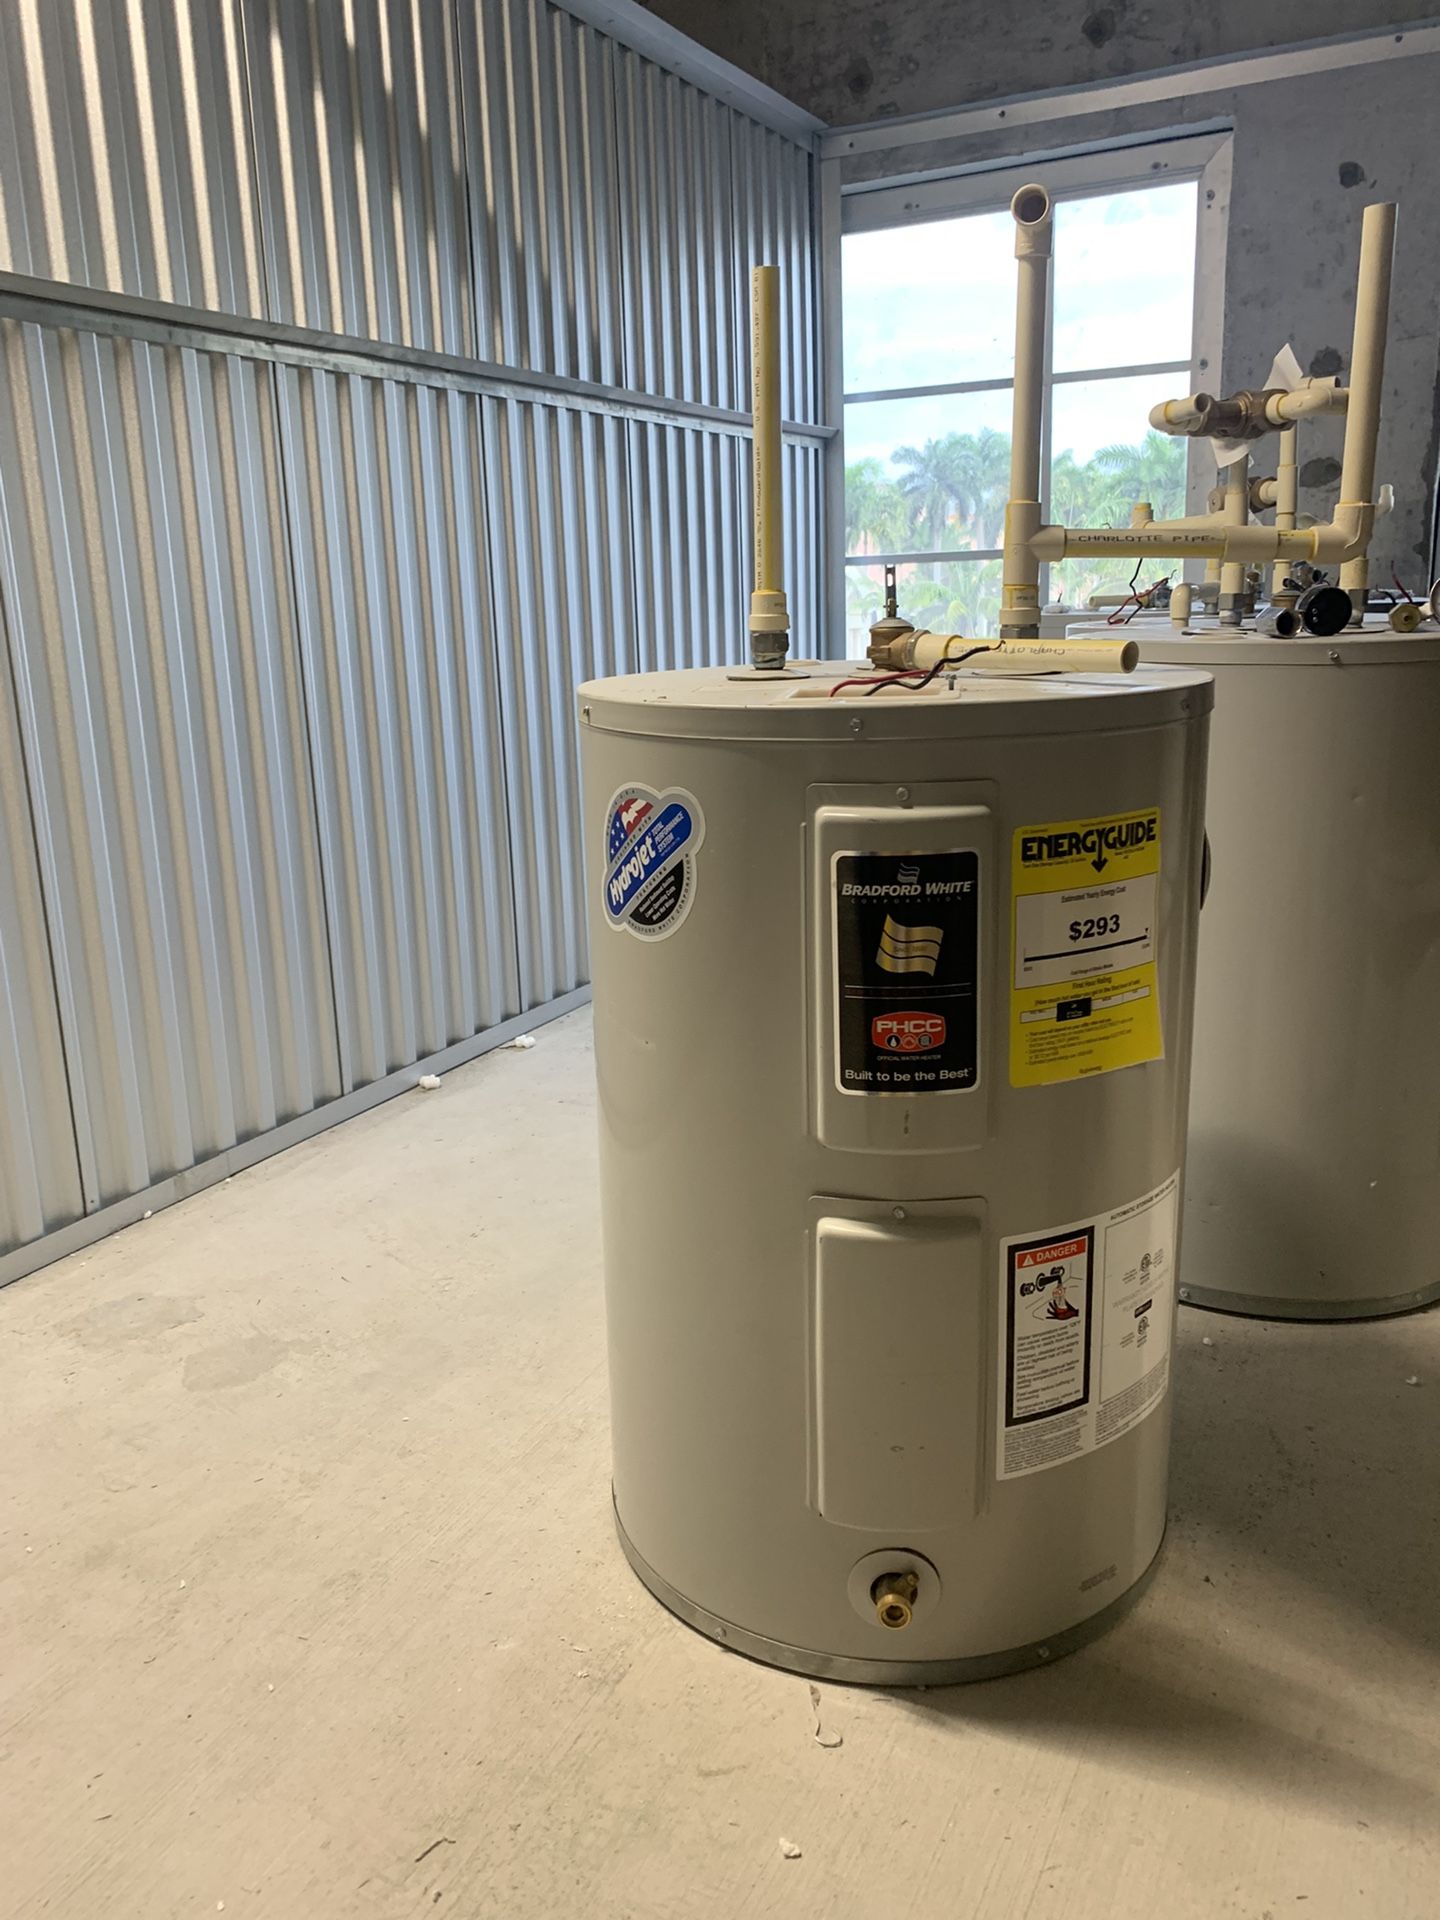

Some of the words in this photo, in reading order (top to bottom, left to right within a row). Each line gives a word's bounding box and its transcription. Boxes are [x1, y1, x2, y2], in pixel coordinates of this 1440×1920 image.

[1078, 534, 1163, 542] CHARLOTTE
[1172, 534, 1210, 542] PIPE
[609, 834, 656, 906] Hydrojet
[841, 883, 921, 897] BRADFORD
[925, 881, 971, 895] WHITE
[1069, 914, 1120, 942] $293
[876, 1019, 942, 1033] PHCC
[844, 1069, 872, 1081] Built
[876, 1071, 890, 1082] to
[893, 1070, 911, 1082] be
[914, 1069, 936, 1081] the
[1036, 1243, 1078, 1262] DANGER
